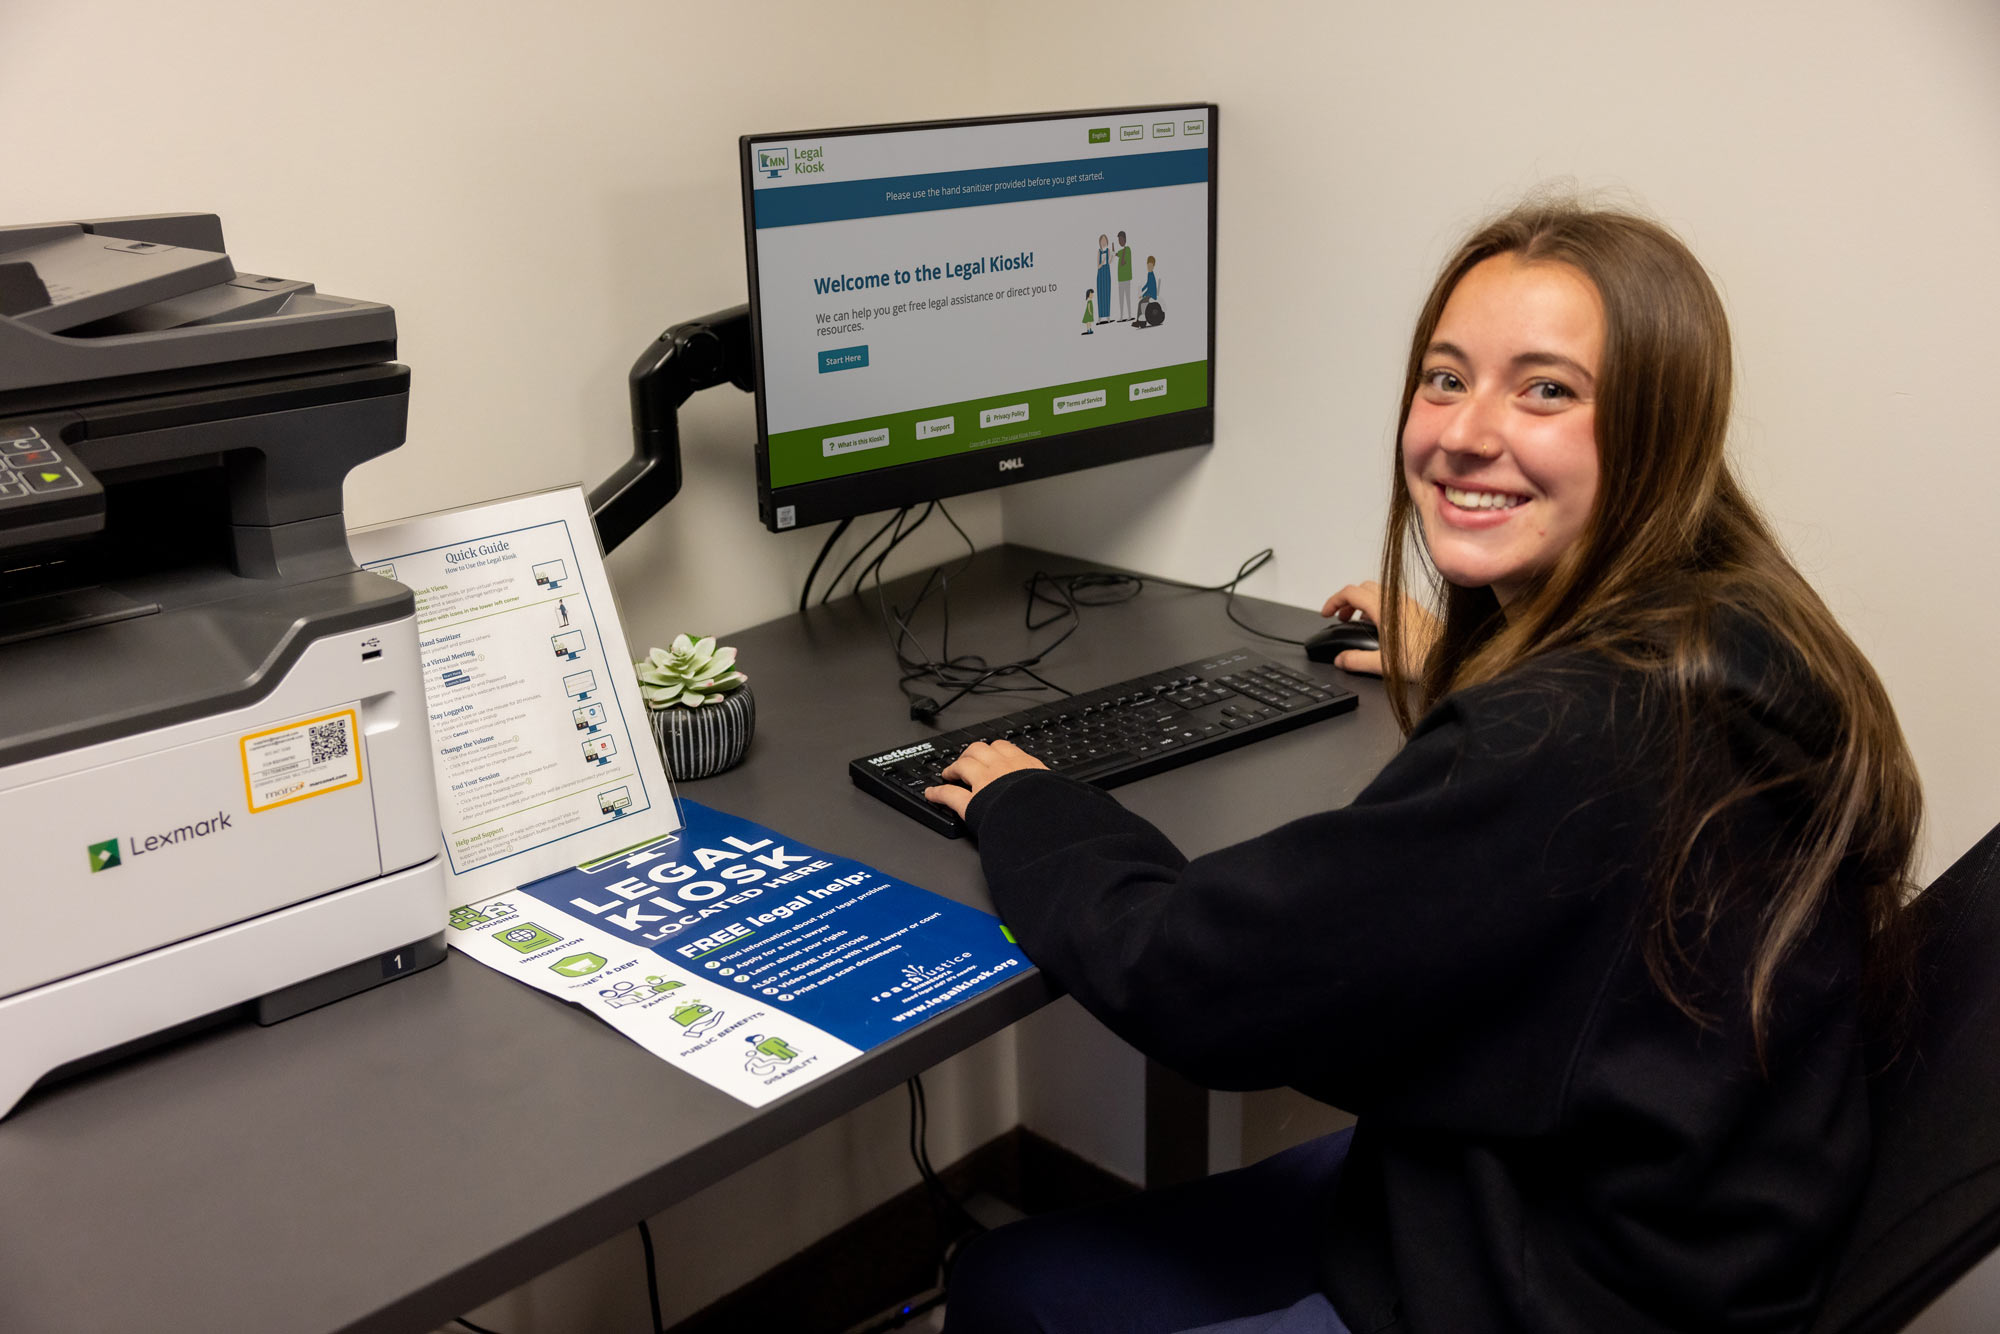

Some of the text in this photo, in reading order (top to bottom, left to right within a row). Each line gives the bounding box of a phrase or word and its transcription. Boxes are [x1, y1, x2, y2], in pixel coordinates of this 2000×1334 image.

[769, 156, 785, 167] MN
[794, 145, 823, 162] Legal
[794, 160, 825, 175] Kiosk
[885, 170, 1105, 201] Please use the hand sanitizer provided before you get started.
[813, 251, 1034, 295] Welcome to the Legal Kiosk!
[815, 283, 1058, 325] We can help you get free legal assistance or direct you to
[816, 322, 865, 337] resources.
[825, 354, 862, 366] Start Here
[1141, 384, 1164, 394] Feedback?
[1066, 400, 1081, 408] Terms
[1086, 396, 1103, 404] Service
[993, 410, 1026, 421] Privacy Policy
[930, 423, 951, 433] Support
[837, 441, 853, 449] What
[857, 438, 869, 446] this
[868, 434, 886, 443] Kiosk?
[999, 457, 1025, 472] DELL
[445, 540, 510, 565] Quick Guide
[379, 567, 393, 575] Legal
[444, 567, 459, 575] How
[476, 560, 486, 568] the
[486, 555, 502, 565] Legal
[501, 553, 517, 561] Kiosk
[412, 584, 449, 598] Kiosk Views
[418, 633, 461, 648] Hand Sanitizer
[430, 655, 451, 666] Virtual
[450, 650, 476, 661] Meeting
[429, 713, 443, 721] Stay
[443, 705, 465, 717] Logged
[452, 729, 469, 738] Cancel
[440, 744, 463, 756] Change
[472, 735, 495, 746] Volume
[867, 742, 933, 765] wetkeys
[451, 772, 501, 792] End Your Session
[130, 811, 233, 857] Lexmark
[455, 827, 504, 848] Help and Support
[569, 835, 774, 915] LEGAL
[604, 845, 812, 932] KIOSK
[641, 859, 833, 941] LOCATED HERE
[474, 910, 520, 932] HOUSING
[676, 871, 872, 959] FREE legal help:
[719, 883, 891, 963] Find information about your legal problem
[519, 937, 585, 964] IMMIGRATION
[735, 954, 763, 969] Apply
[761, 948, 777, 957] for
[783, 937, 803, 947] free
[800, 924, 831, 939] lawyer
[748, 929, 848, 976] Learn about your rights
[777, 974, 807, 988] Video
[806, 957, 844, 977] meeting
[841, 949, 863, 960] with
[861, 940, 882, 952] your
[880, 927, 909, 942] lawyer
[919, 912, 942, 924] court
[394, 954, 402, 970] 1
[613, 959, 639, 973] DEBT
[751, 934, 869, 990] ALSO AT SOME LOCATIONS
[792, 944, 903, 996] Print and scan documents
[641, 991, 676, 1009] FAMILY
[891, 958, 1019, 1022] www.legalkiosk.org
[917, 985, 934, 996] legal
[680, 1012, 765, 1057] PUBLIC BENEFITS
[763, 1055, 818, 1085] DISABILITY
